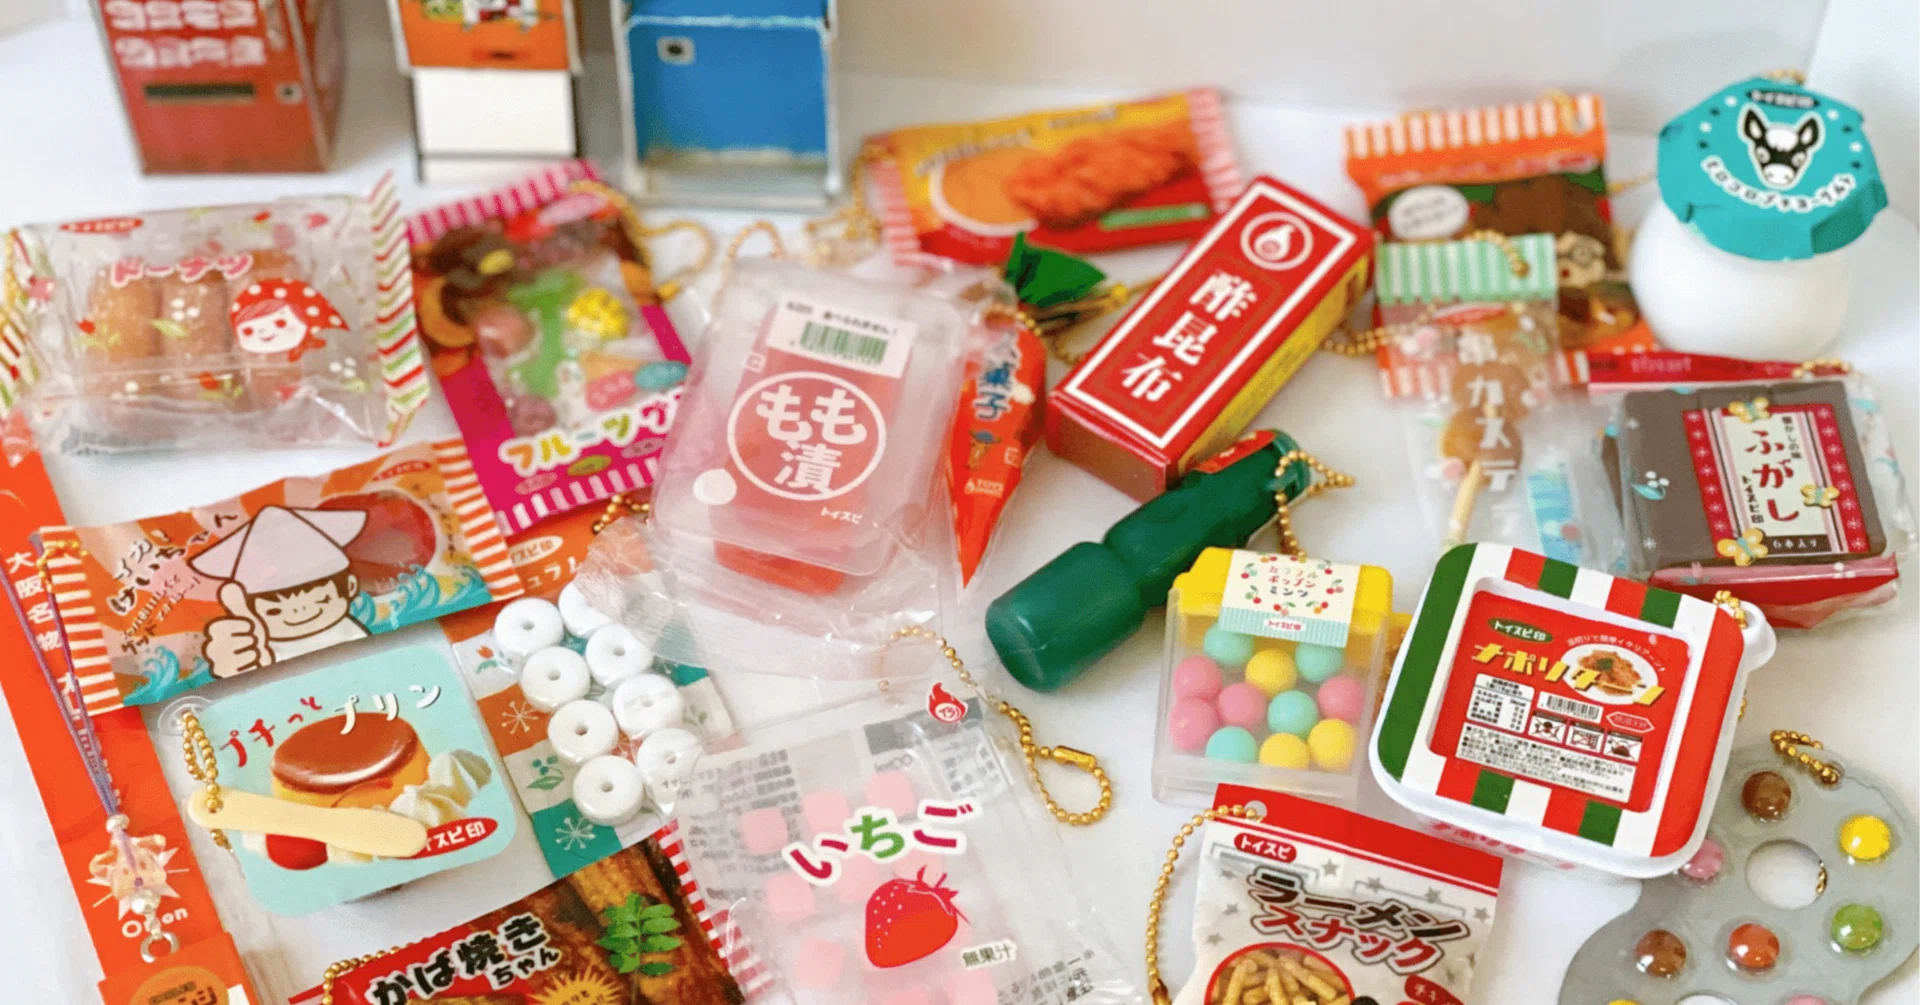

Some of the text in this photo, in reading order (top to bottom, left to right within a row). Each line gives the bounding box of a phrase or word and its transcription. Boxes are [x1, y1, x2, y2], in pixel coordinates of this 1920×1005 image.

[110, 252, 253, 288] ドーナツ
[1121, 270, 1257, 402] 酢昆布
[756, 384, 868, 445] もも
[774, 439, 843, 494] 漬
[1743, 429, 1800, 522] ふがし
[820, 506, 863, 525] トイスピ
[1741, 475, 1765, 524] トイスピ印
[107, 513, 239, 614] けいちゃん
[6, 551, 63, 652] 大阪名物
[1493, 621, 1548, 643] トイスピ印
[1470, 642, 1666, 706] ナポリターン
[219, 695, 323, 768] プチっと
[332, 684, 441, 736] プリン
[425, 820, 487, 852] イスピ印
[787, 801, 977, 882] いちご
[1240, 834, 1292, 860] トイスピ
[121, 907, 189, 939] Oon
[1252, 871, 1463, 938] ラーメン
[371, 915, 549, 1005] かば焼き
[961, 943, 1012, 967] 無果汁
[1260, 903, 1438, 968] スナック
[491, 947, 560, 986] ちゃん
